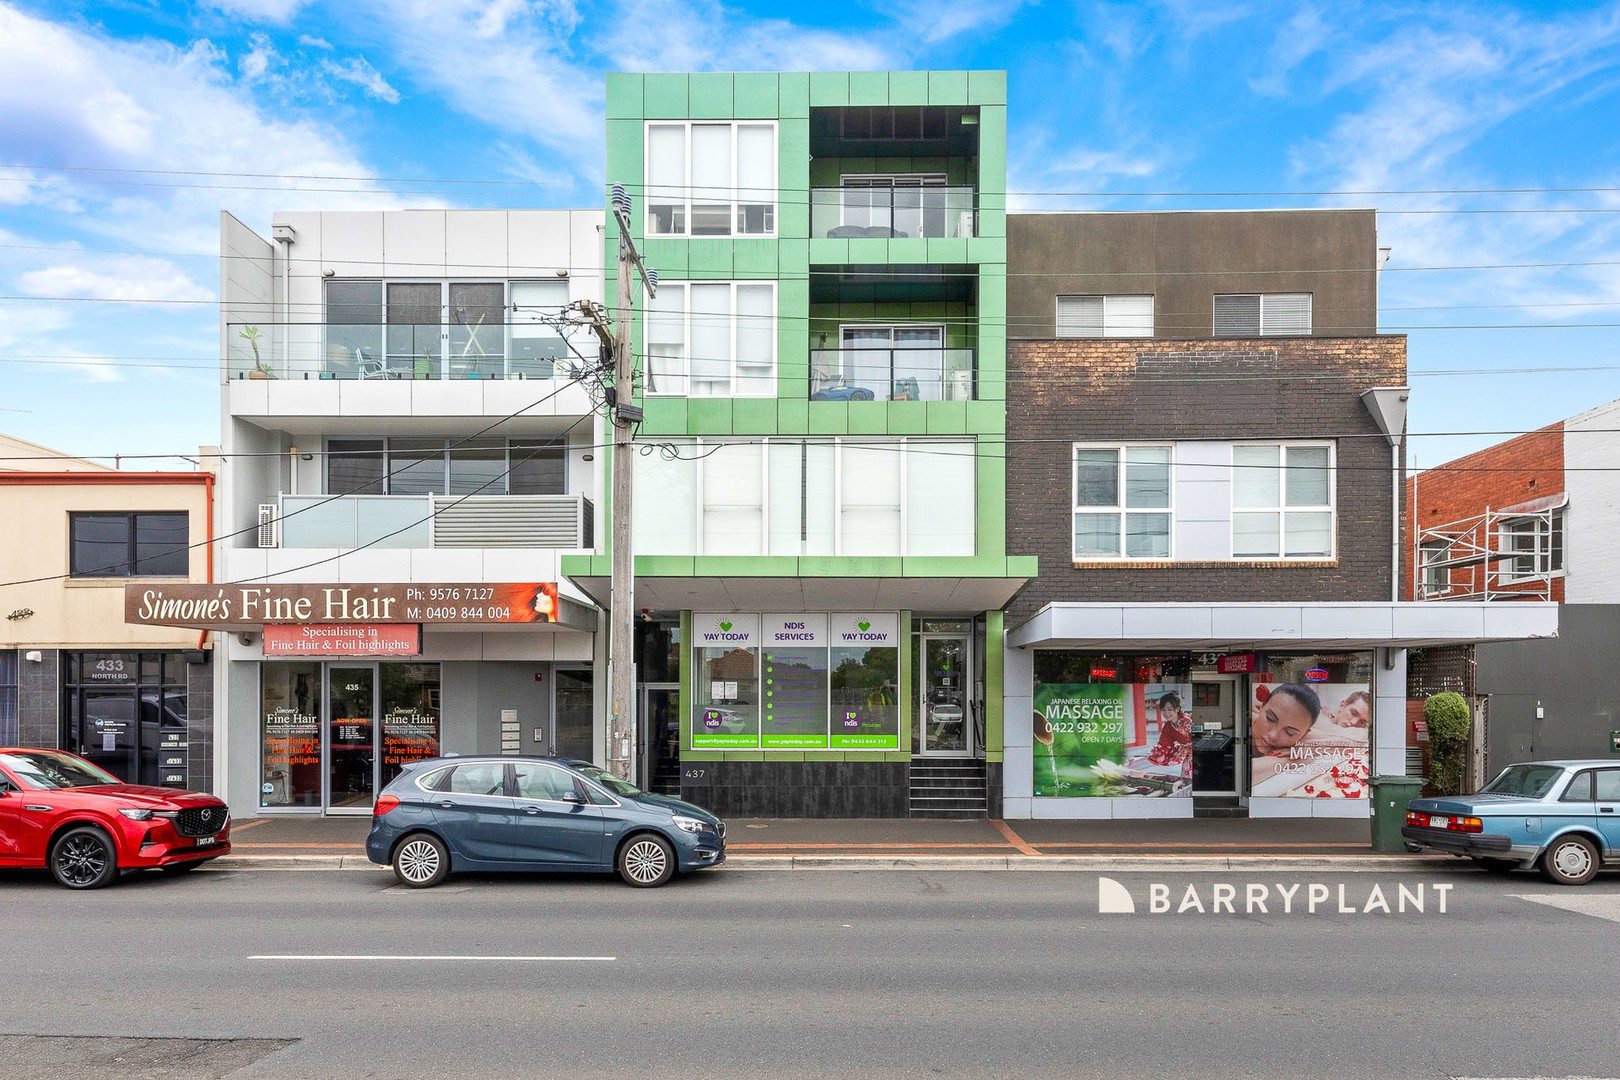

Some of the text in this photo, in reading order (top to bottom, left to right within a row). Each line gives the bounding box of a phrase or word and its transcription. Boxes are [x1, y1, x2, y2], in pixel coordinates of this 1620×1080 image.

[406, 588, 494, 600] Ph: 9576 7127
[138, 587, 396, 620] Simone's Fine Hair
[406, 607, 511, 619] M: 0409 844 004
[784, 622, 805, 630] NDIS
[302, 627, 378, 638] Specialising in
[704, 633, 750, 641] YAY TODAY
[774, 633, 815, 641] SERVICES
[842, 633, 888, 641] YAY TODAY
[271, 640, 410, 652] Fine Hair & Foil highlights
[1198, 653, 1227, 665] 43
[96, 660, 124, 671] 433
[1224, 661, 1247, 671] MASSAGE
[1305, 671, 1329, 679] OPEN
[1045, 704, 1123, 719] MASSAGE
[266, 713, 317, 724] Fine Hair
[384, 713, 435, 724] Fine Hair
[1045, 722, 1123, 733] 0422 932 297
[266, 736, 319, 746] Specialising in
[384, 737, 427, 746] Specialising
[1290, 747, 1361, 760] MASSAGE
[266, 755, 319, 766] Foil highlights
[384, 756, 399, 764] Foil
[685, 769, 705, 778] 437
[1274, 762, 1362, 774] 0422 932 297
